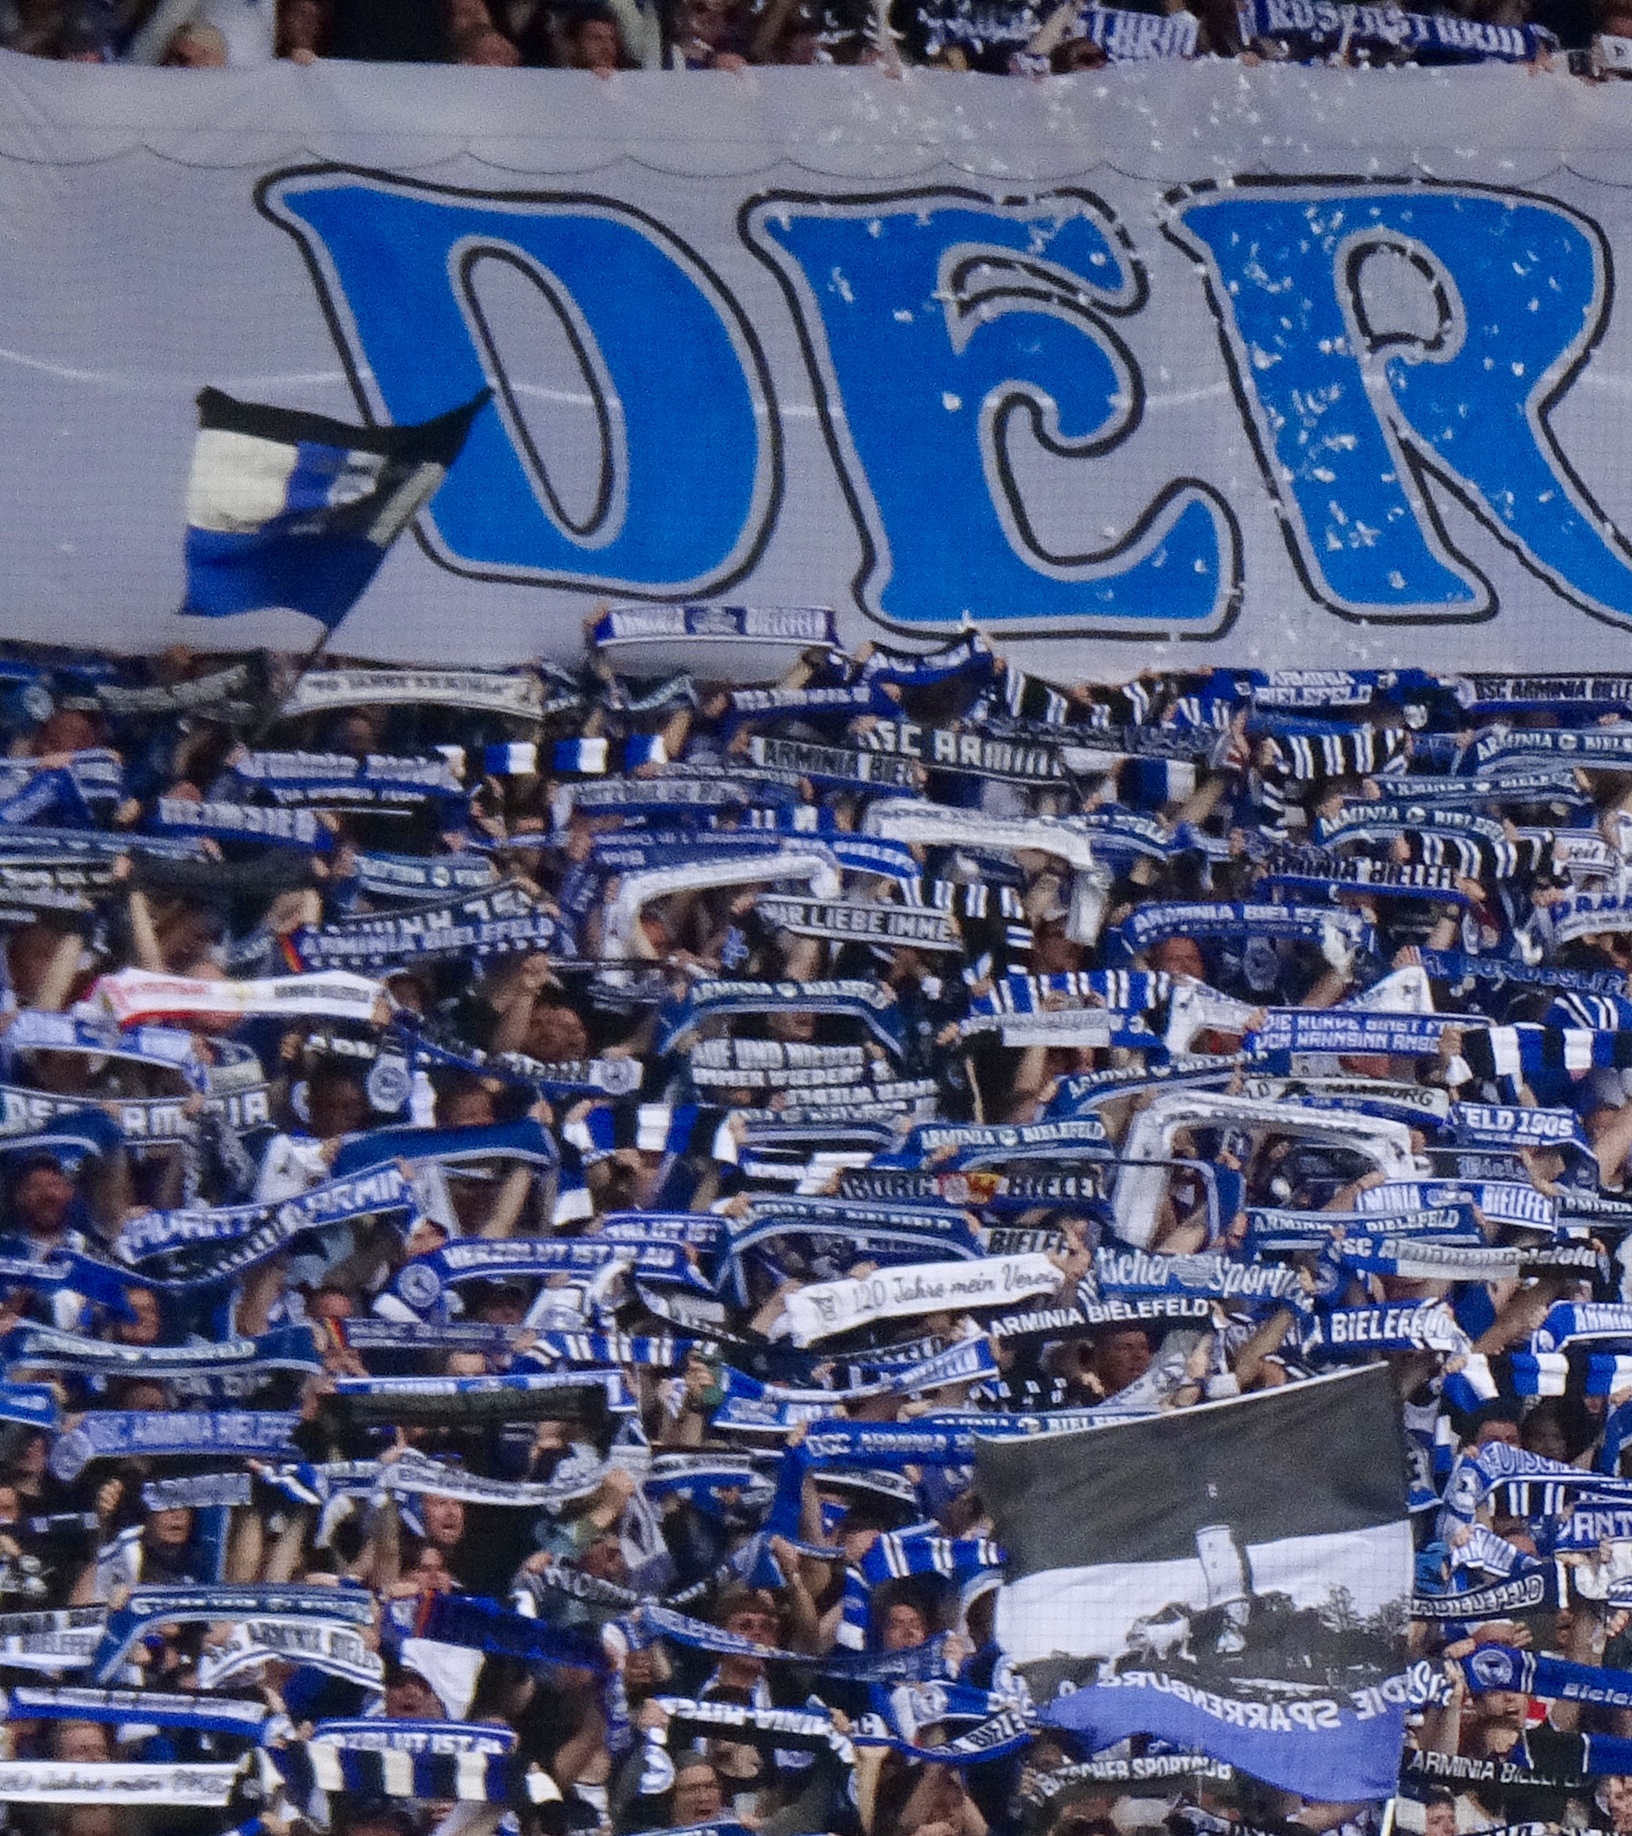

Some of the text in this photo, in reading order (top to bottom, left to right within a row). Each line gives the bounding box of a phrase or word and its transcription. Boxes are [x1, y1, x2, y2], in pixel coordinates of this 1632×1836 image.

[1476, 732, 1554, 762] ARMINIA
[1518, 1109, 1574, 1137] 1905
[991, 1299, 1210, 1337] ARMINIA BIELEFELD
[1408, 1749, 1495, 1782] ARMINIA
